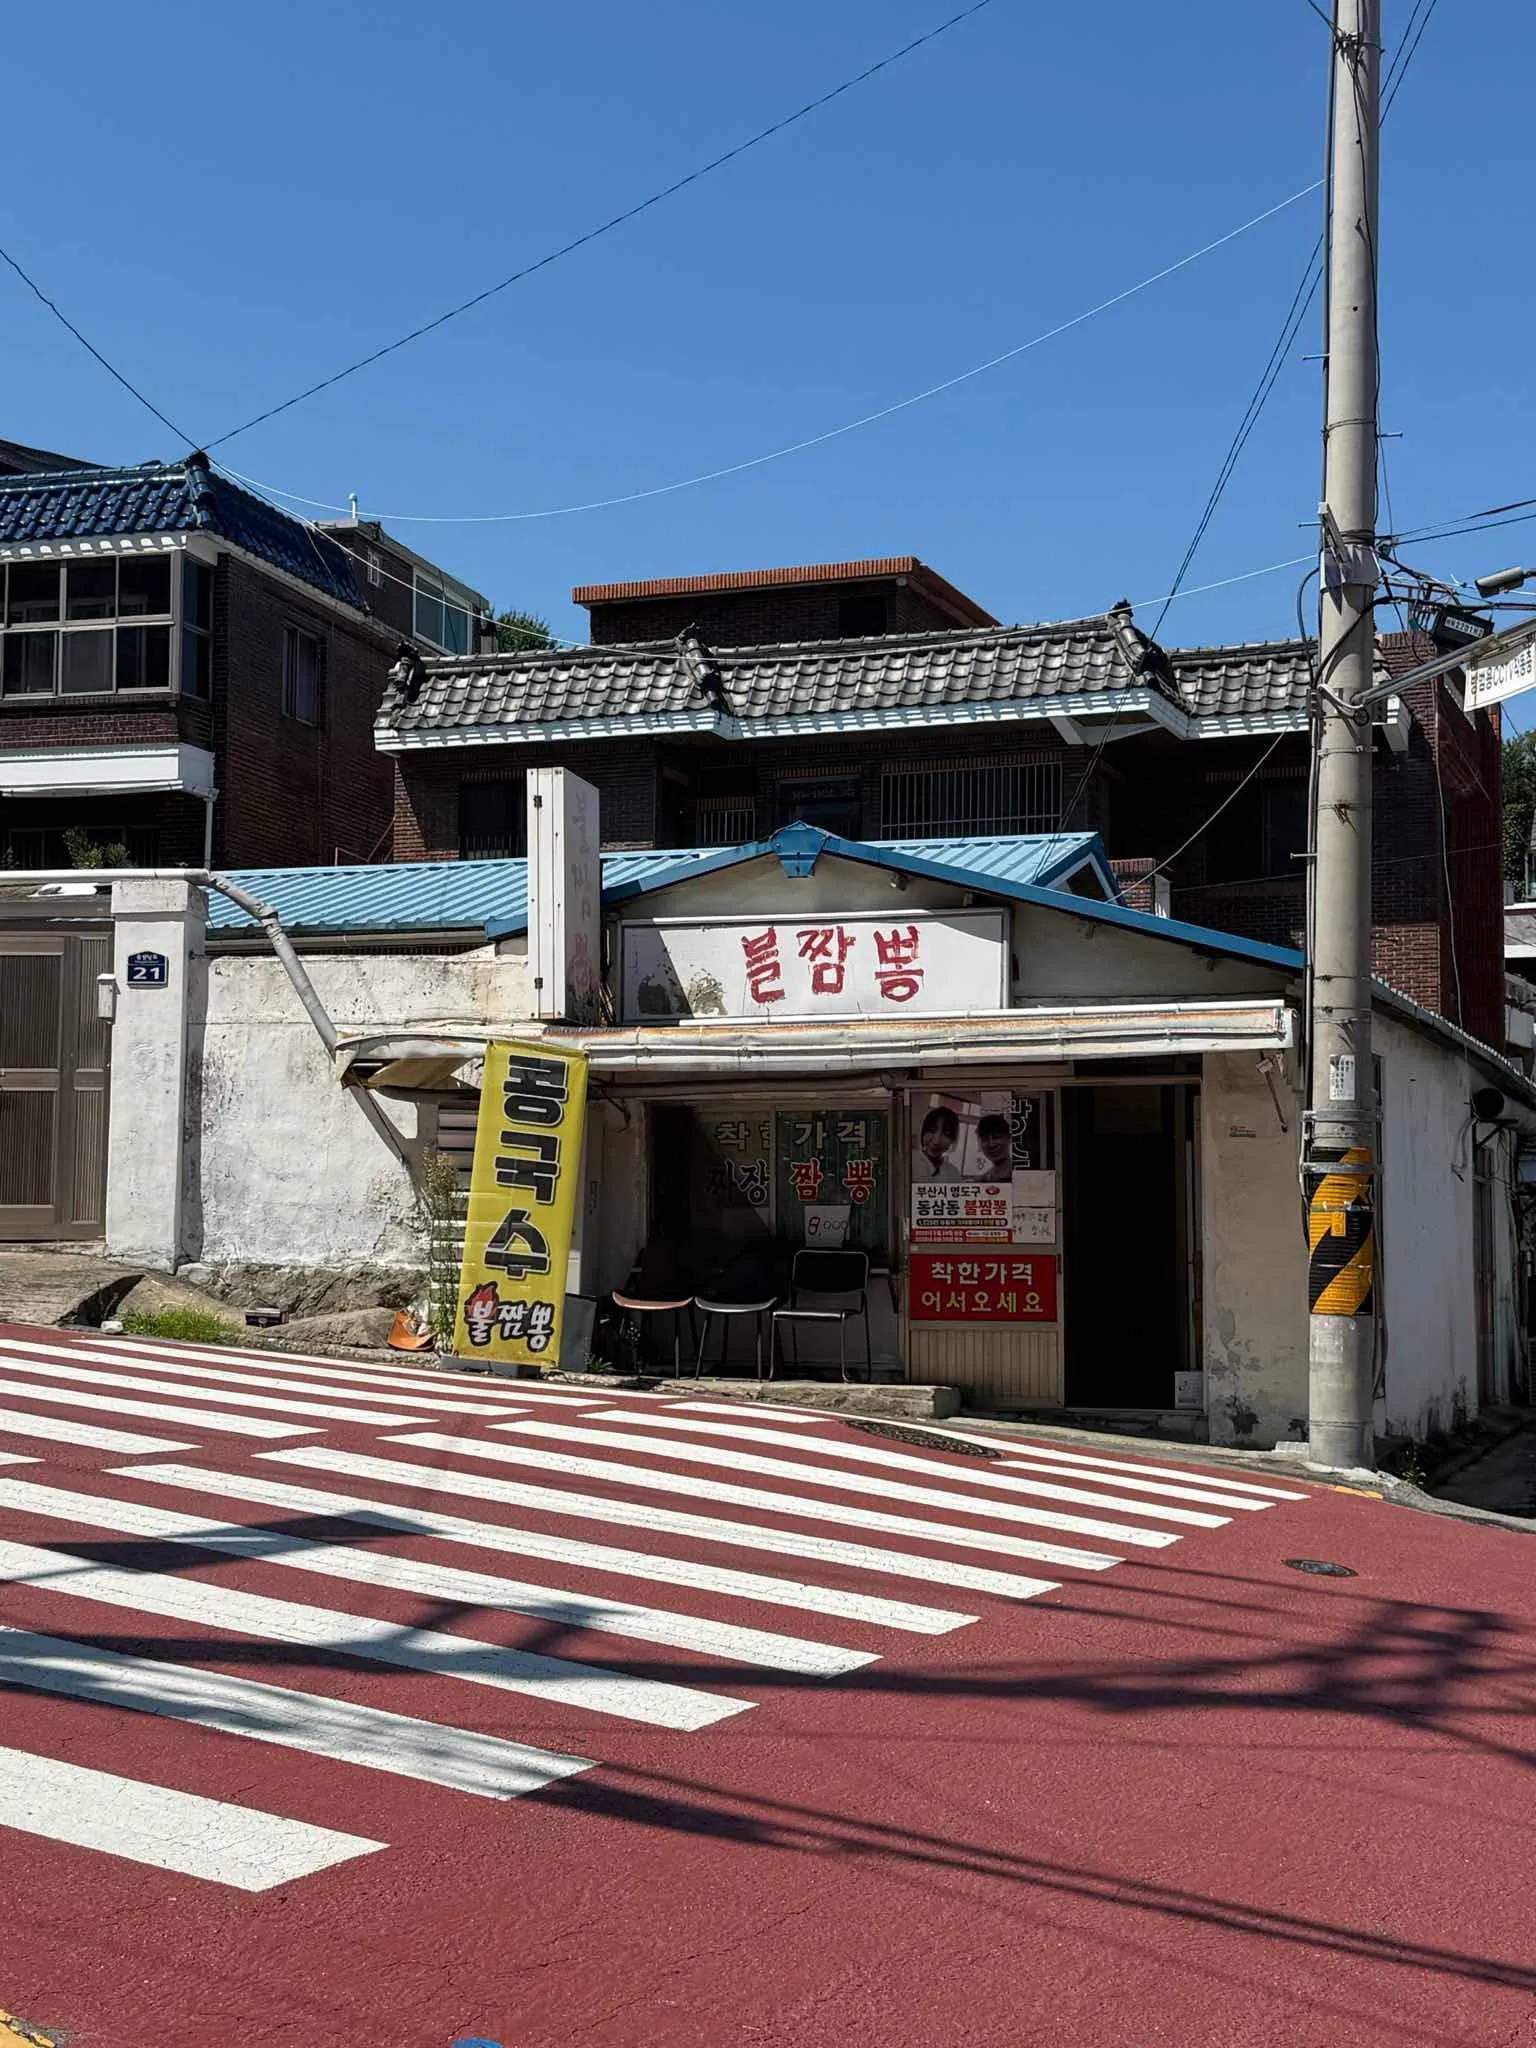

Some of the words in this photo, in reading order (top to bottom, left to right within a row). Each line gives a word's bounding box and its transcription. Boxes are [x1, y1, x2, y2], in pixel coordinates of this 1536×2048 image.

[133, 966, 160, 980] 21
[483, 1053, 568, 1279] 콩국수
[790, 1157, 876, 1204] 짬뽕
[916, 1186, 947, 1198] 부산시
[950, 1186, 981, 1198] 영도구
[916, 1200, 961, 1216] 동삼동
[964, 1200, 1008, 1216] 불짬뽕
[920, 1291, 1044, 1313] 어서오세요
[467, 1300, 551, 1351] 불짬뽕
